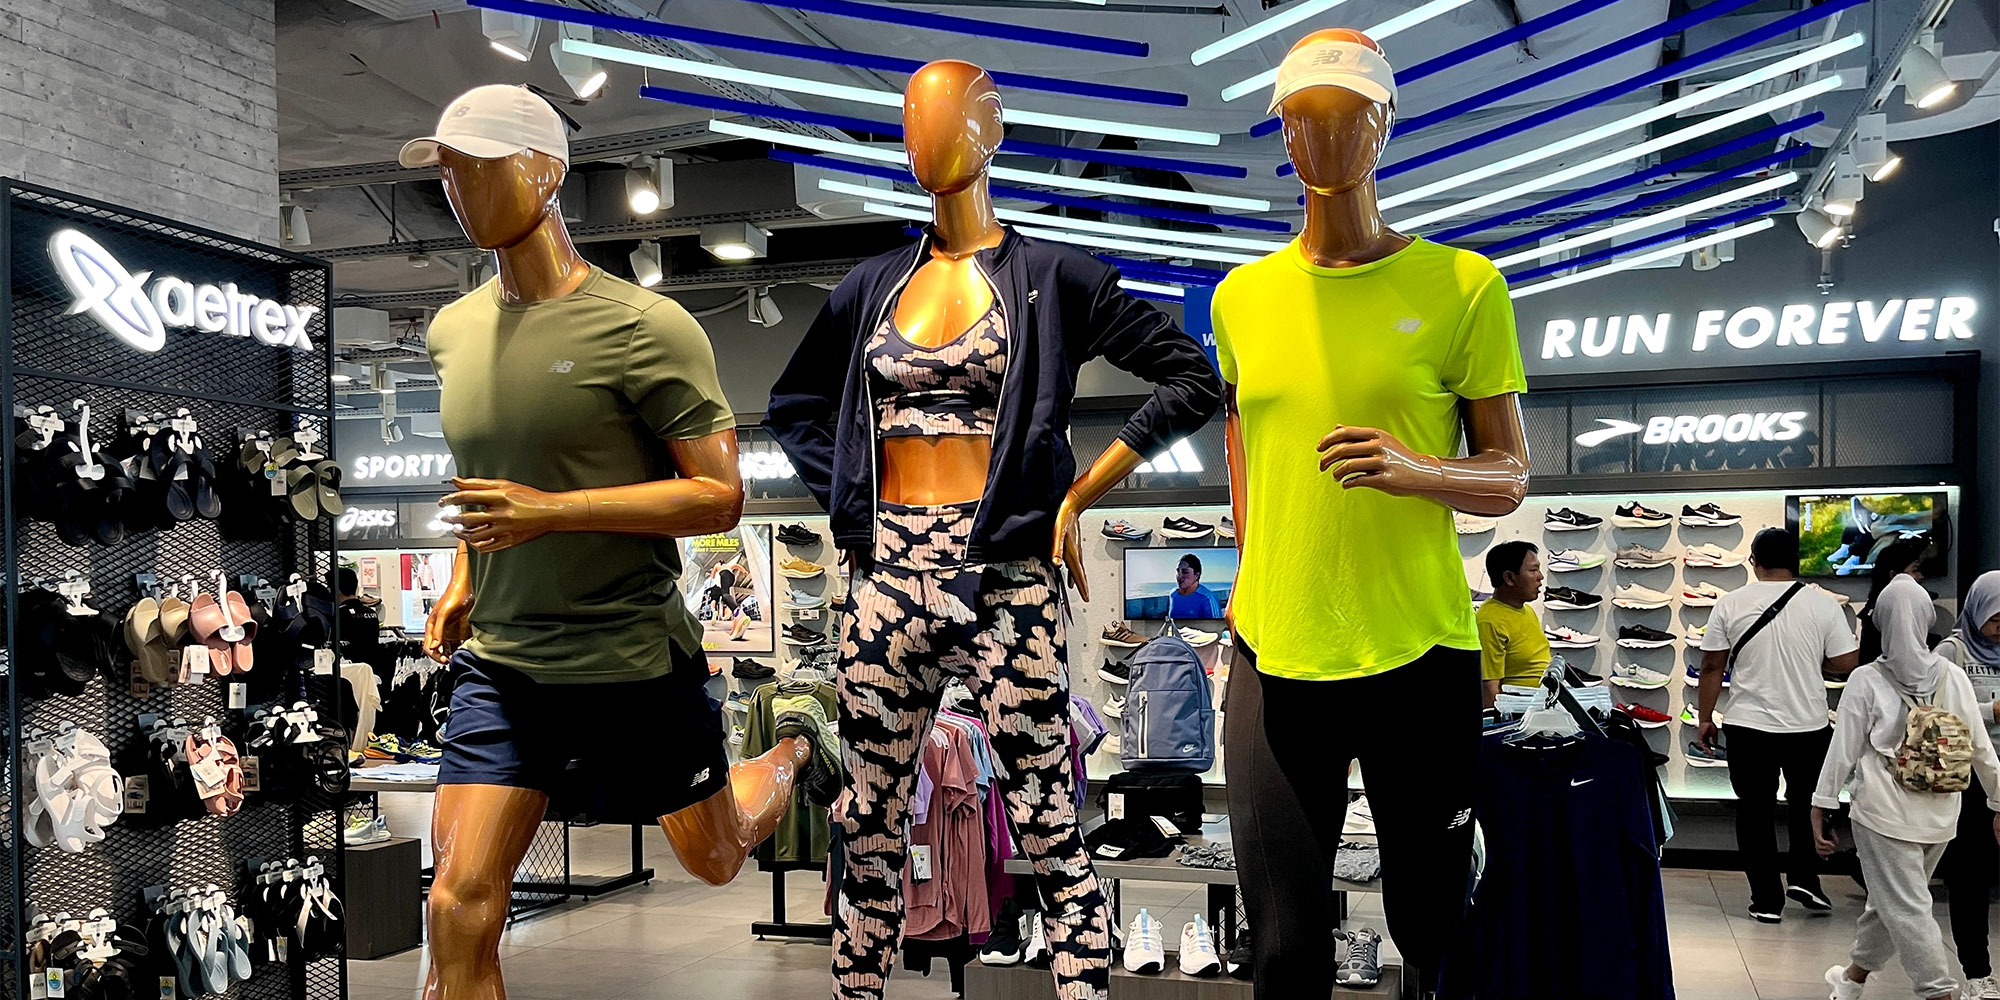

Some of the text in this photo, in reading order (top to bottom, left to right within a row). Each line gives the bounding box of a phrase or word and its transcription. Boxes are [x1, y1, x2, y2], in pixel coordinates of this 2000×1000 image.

[151, 276, 319, 350] aetrex
[1541, 296, 1978, 360] RUN FOREVER
[1643, 411, 1808, 445] BROOKS
[354, 454, 452, 479] SPORTY
[692, 538, 739, 547] MORE MILES
